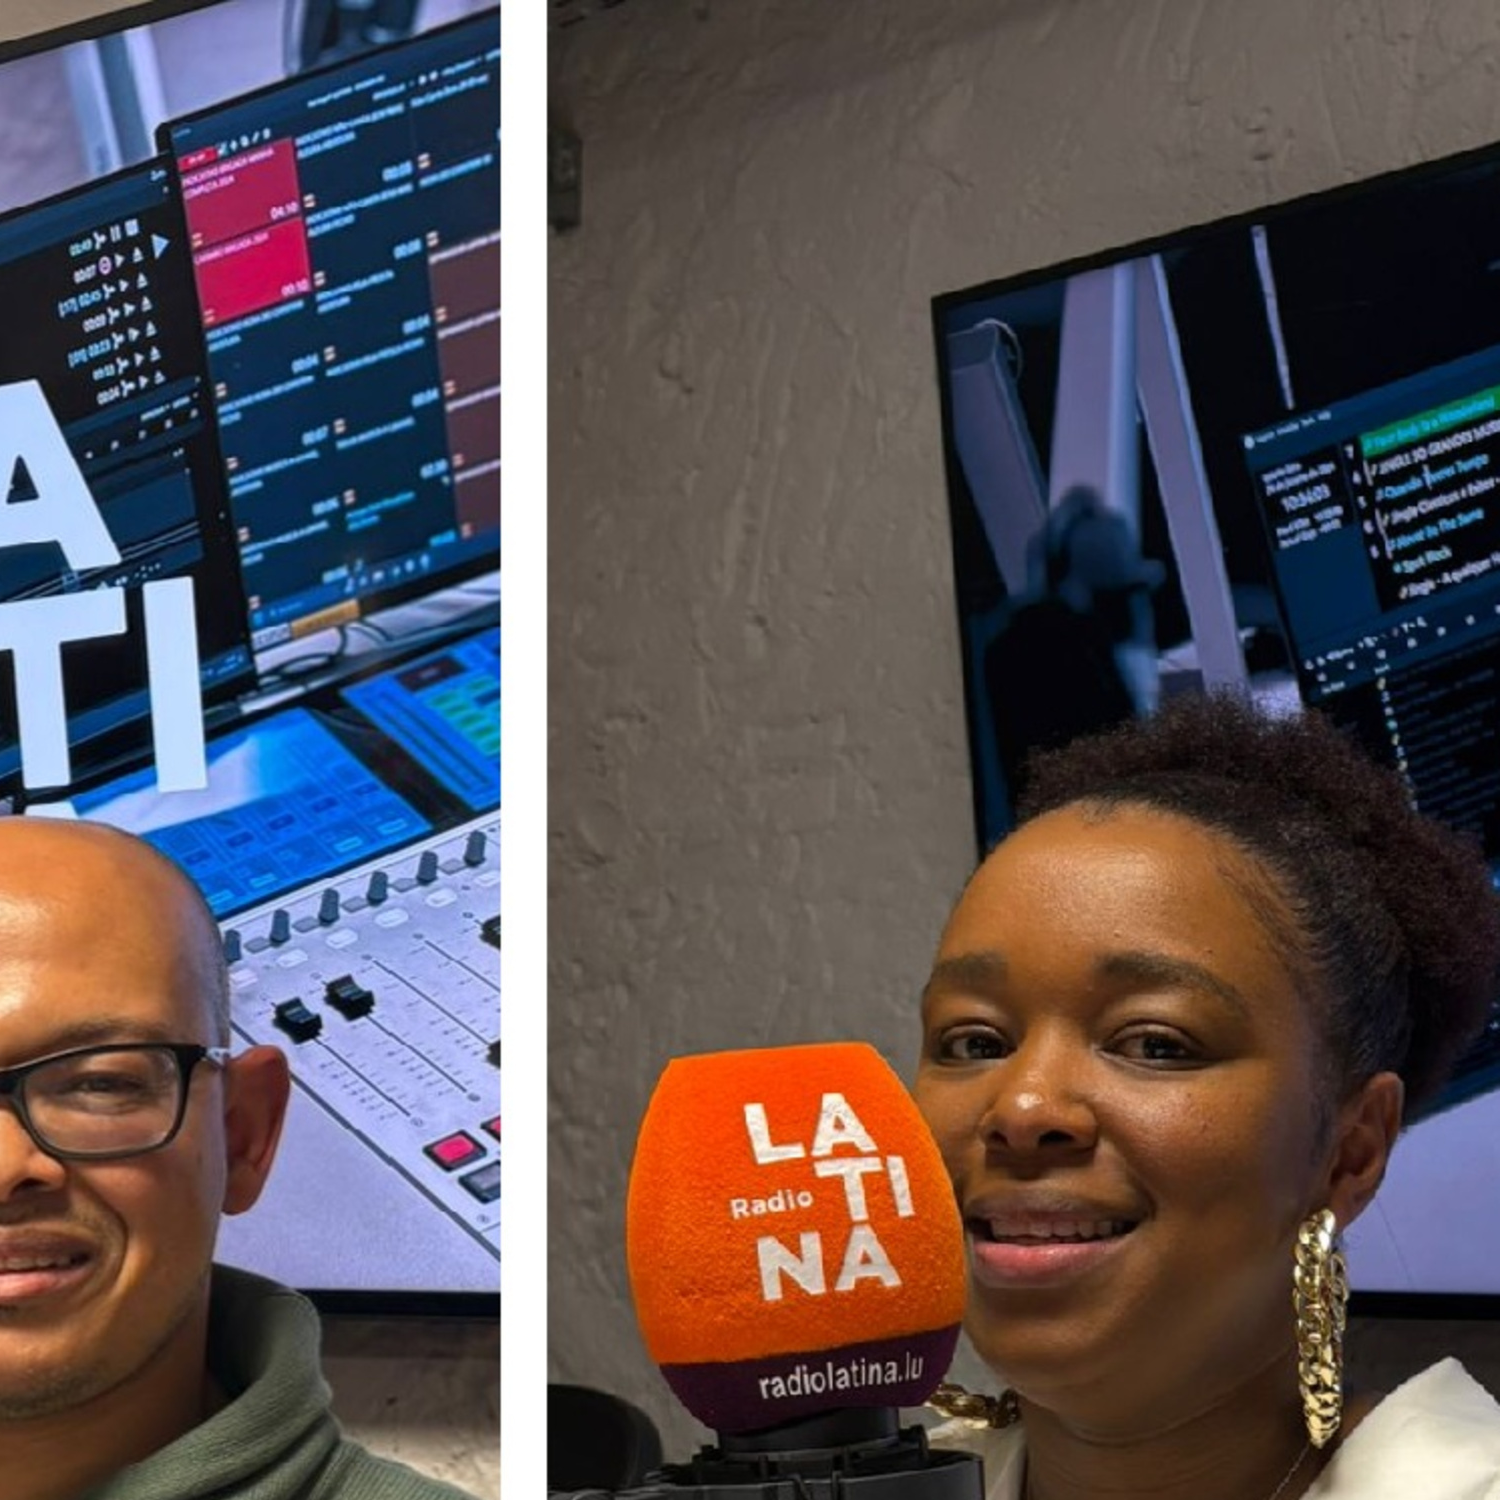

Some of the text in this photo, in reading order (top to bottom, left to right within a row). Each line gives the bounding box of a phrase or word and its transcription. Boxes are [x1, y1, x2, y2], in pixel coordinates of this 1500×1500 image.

[743, 1092, 880, 1166] LA
[730, 1188, 815, 1220] Radio
[812, 1155, 915, 1222] TI
[756, 1222, 903, 1303] NA
[758, 1351, 924, 1400] radiolatina.lu
